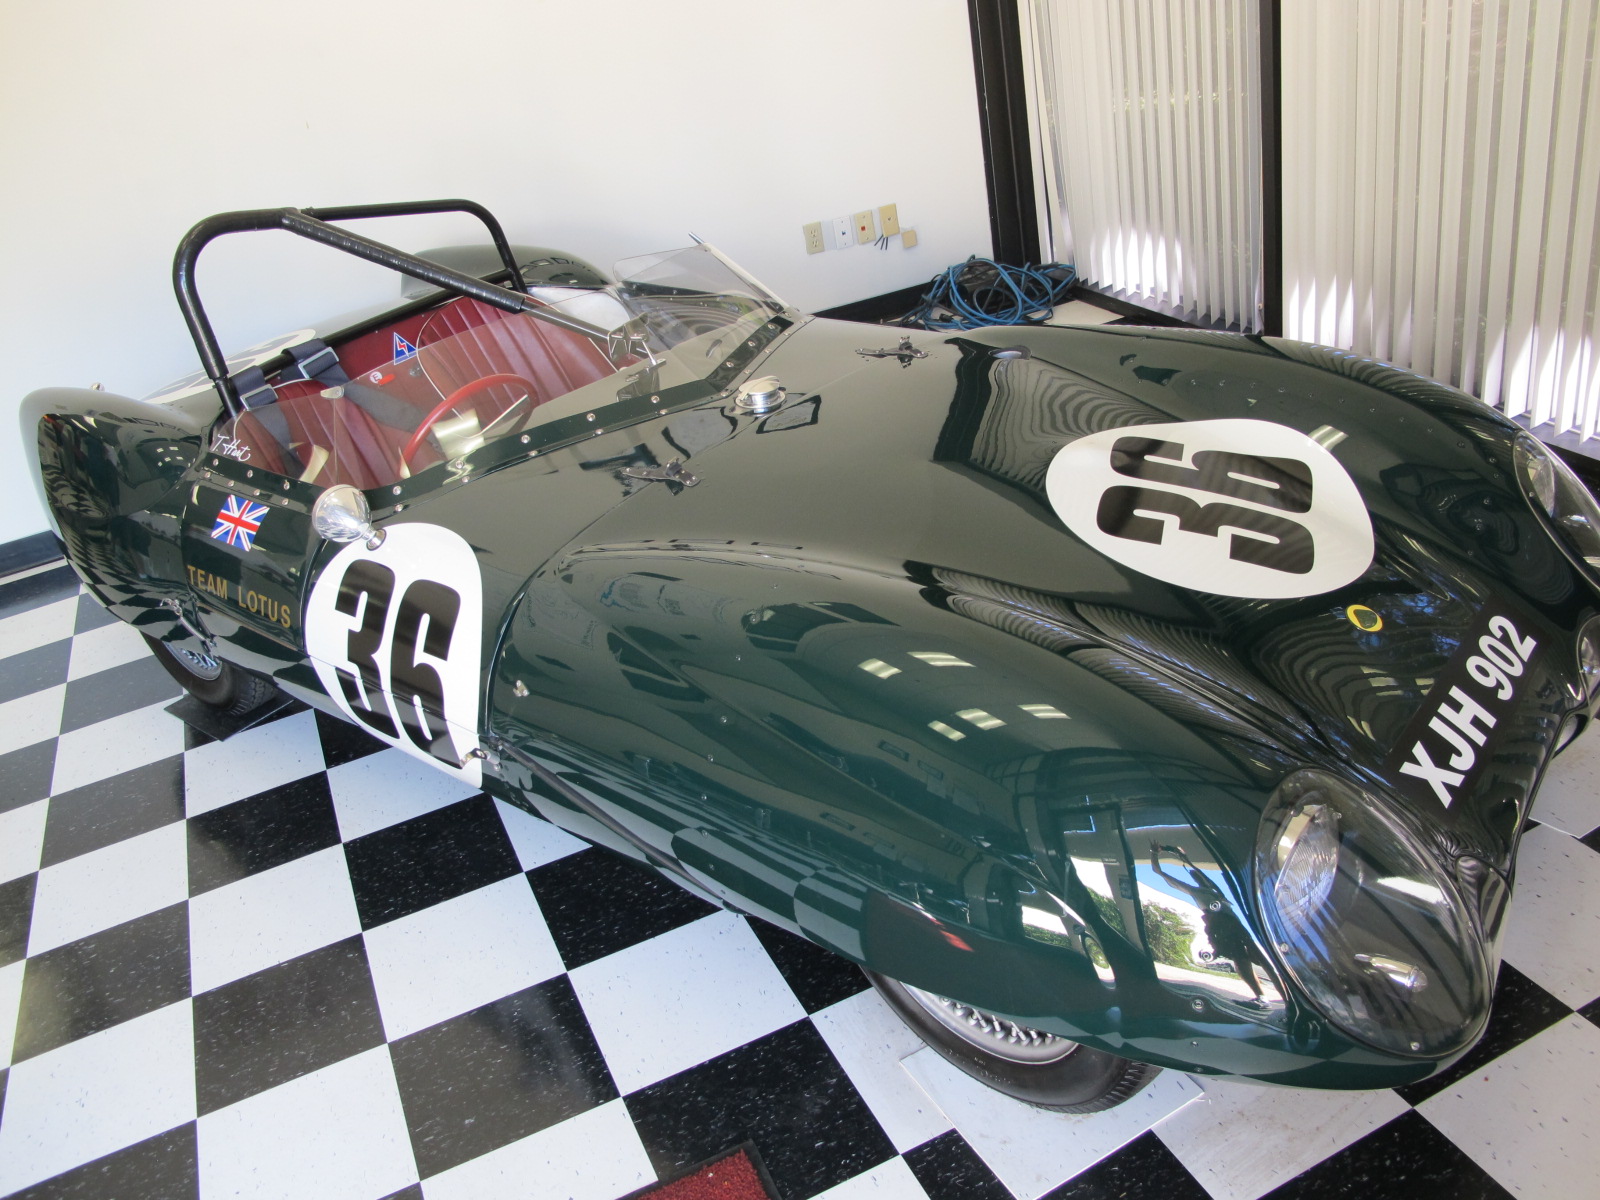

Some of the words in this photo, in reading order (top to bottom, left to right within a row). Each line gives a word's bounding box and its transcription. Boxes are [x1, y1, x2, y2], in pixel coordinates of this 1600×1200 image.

[1096, 436, 1315, 574] 36
[187, 564, 228, 600] TEAM
[237, 585, 291, 628] LOTUS
[334, 558, 463, 770] 36
[1398, 685, 1497, 809] XJH
[1465, 615, 1537, 700] 902
